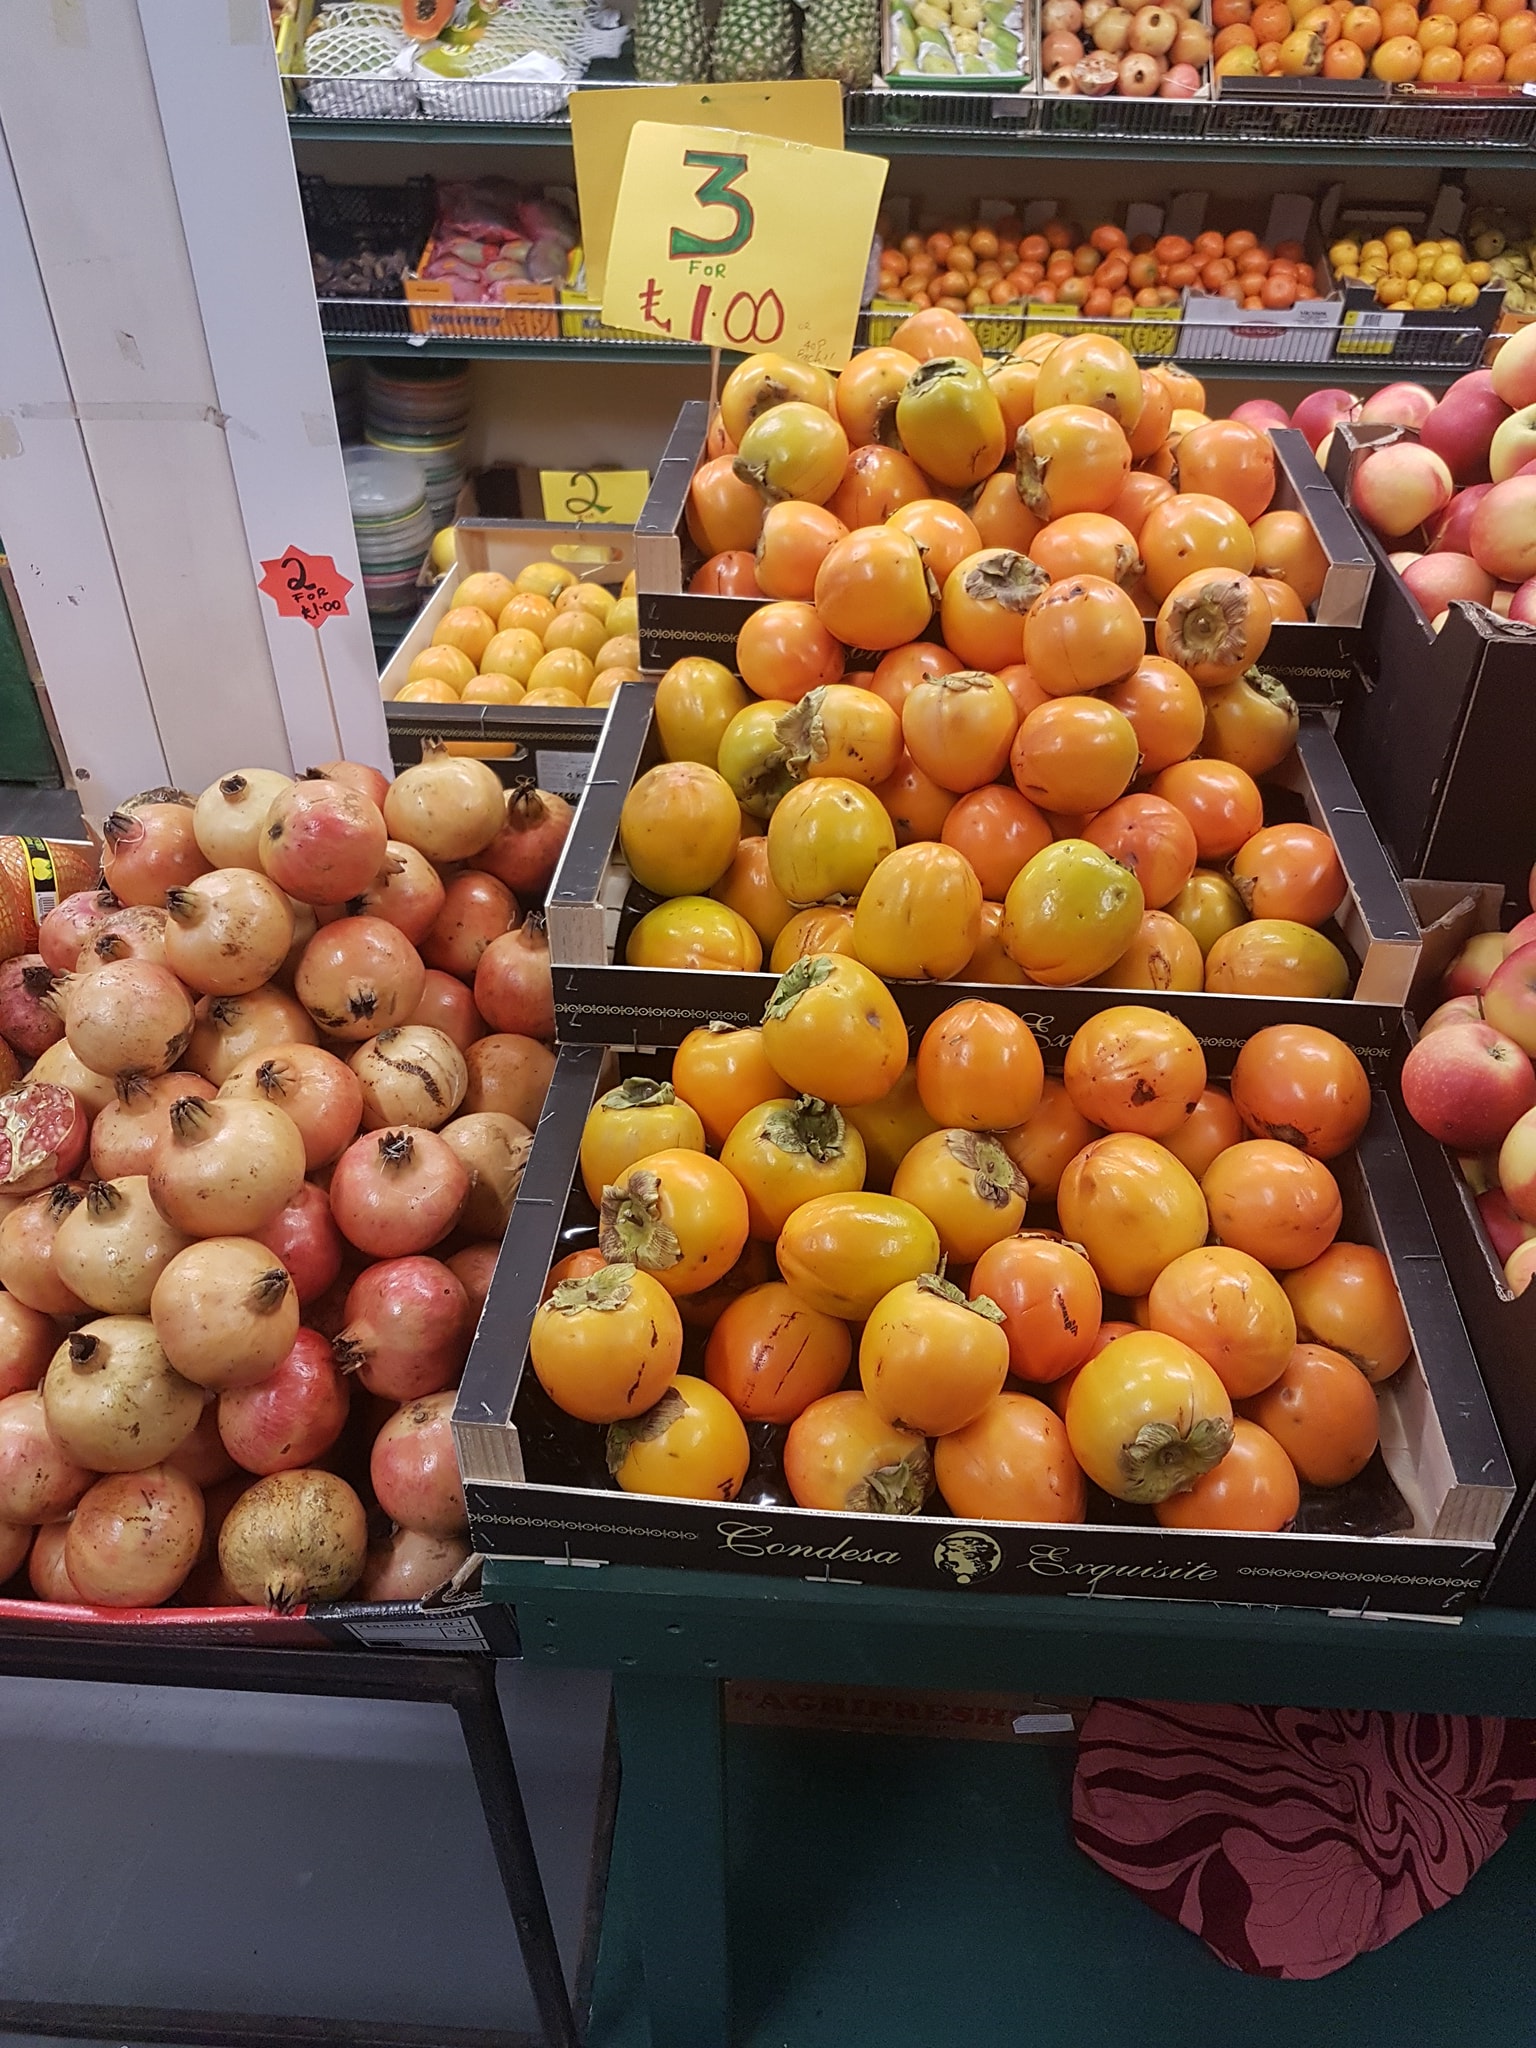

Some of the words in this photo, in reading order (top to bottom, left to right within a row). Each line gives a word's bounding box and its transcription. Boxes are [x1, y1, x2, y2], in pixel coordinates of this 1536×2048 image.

[669, 149, 755, 260] 3
[688, 260, 727, 279] FOR
[565, 471, 613, 515] 2
[281, 557, 317, 591] 2
[291, 587, 329, 604] FOR
[301, 600, 342, 620] £1.00
[716, 1520, 902, 1567] Condesa
[1016, 1542, 1219, 1583] Exquisite
